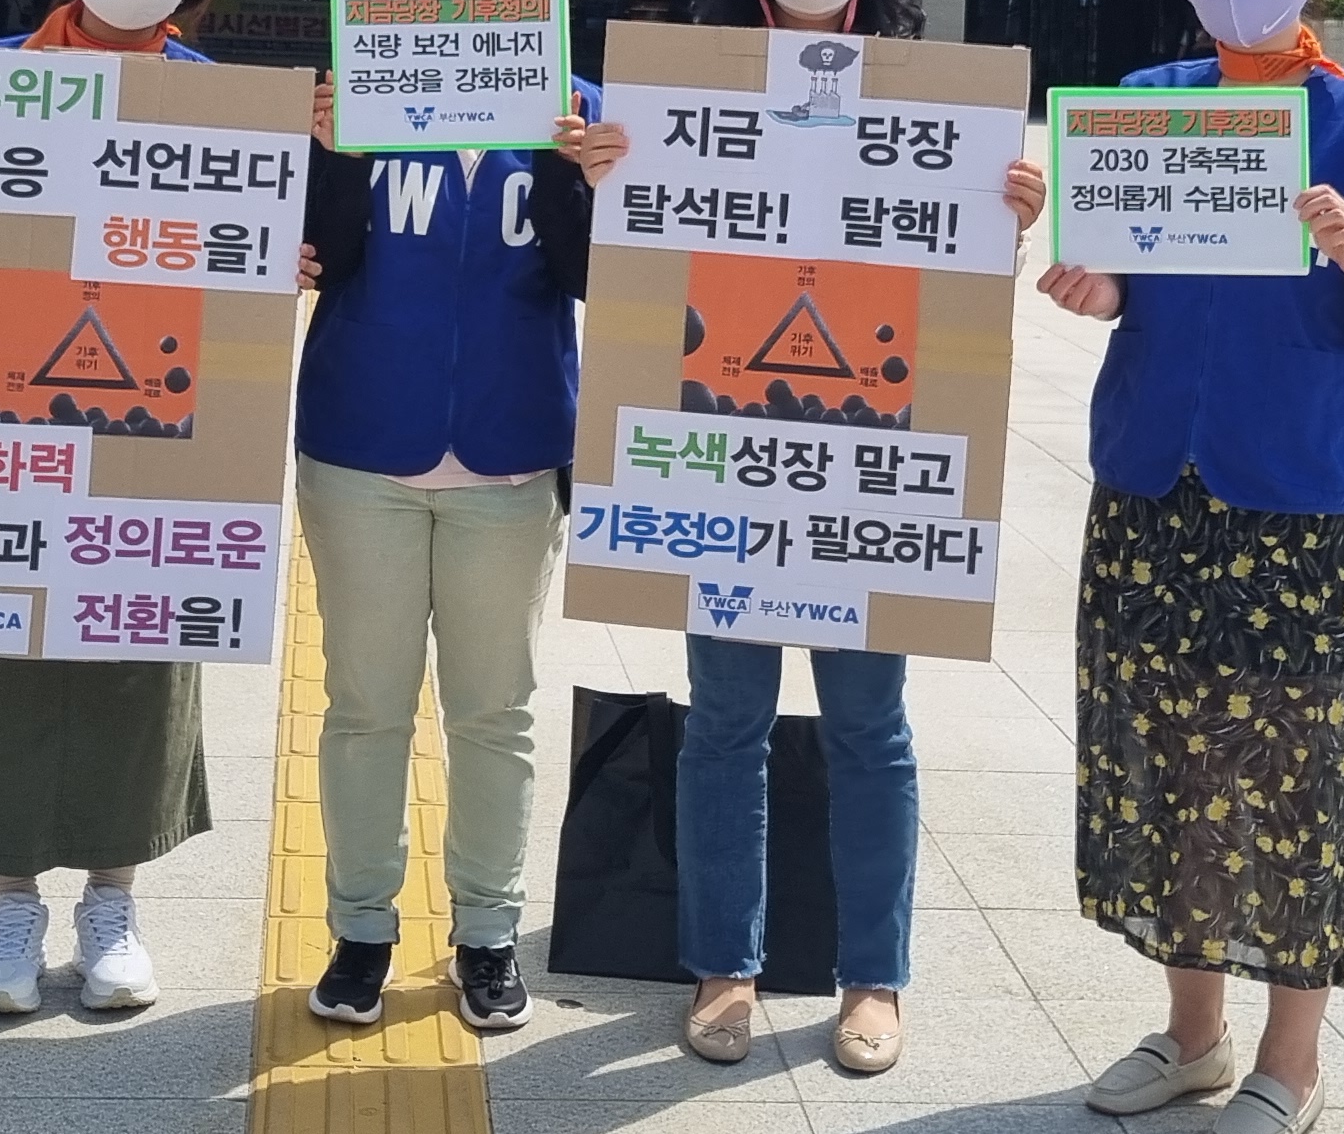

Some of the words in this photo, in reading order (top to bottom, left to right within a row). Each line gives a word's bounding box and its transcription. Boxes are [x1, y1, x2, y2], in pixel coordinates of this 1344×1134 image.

[346, 0, 442, 25] 지금당장
[353, 33, 401, 58] 식량
[412, 33, 460, 57] 보건
[472, 31, 544, 56] 에너지
[348, 68, 443, 95] 공공성을
[455, 66, 548, 93] 강화하라
[439, 111, 495, 123] 부산YWCA
[1069, 109, 1171, 137] 지금당장
[1181, 109, 1291, 137] 기후정의!
[663, 106, 763, 160] 지금
[856, 115, 959, 170] 당장
[92, 138, 295, 200] 선언보다
[1089, 148, 1149, 172] 2030
[1162, 147, 1268, 174] 감축목표
[1070, 184, 1172, 212] 정의롭게
[1183, 185, 1288, 213] 수립하라
[622, 183, 790, 245] 탈석탄!
[840, 196, 959, 255] 탈핵!
[102, 215, 271, 276] 행동을!
[1166, 233, 1228, 245] 부산YWCA
[797, 265, 816, 275] 기후
[76, 346, 99, 357] 기후
[790, 332, 814, 344] 기후
[790, 345, 814, 357] 위기
[76, 359, 99, 370] 위기
[626, 424, 834, 493] 녹색성장
[854, 444, 955, 496] 말고
[64, 514, 267, 570] 정의로운
[577, 503, 793, 567] 기후정의가
[805, 513, 983, 575] 필요하다
[702, 595, 748, 611] YWCA
[758, 598, 860, 625] 부산YWCA
[73, 593, 244, 648] 전환을!
